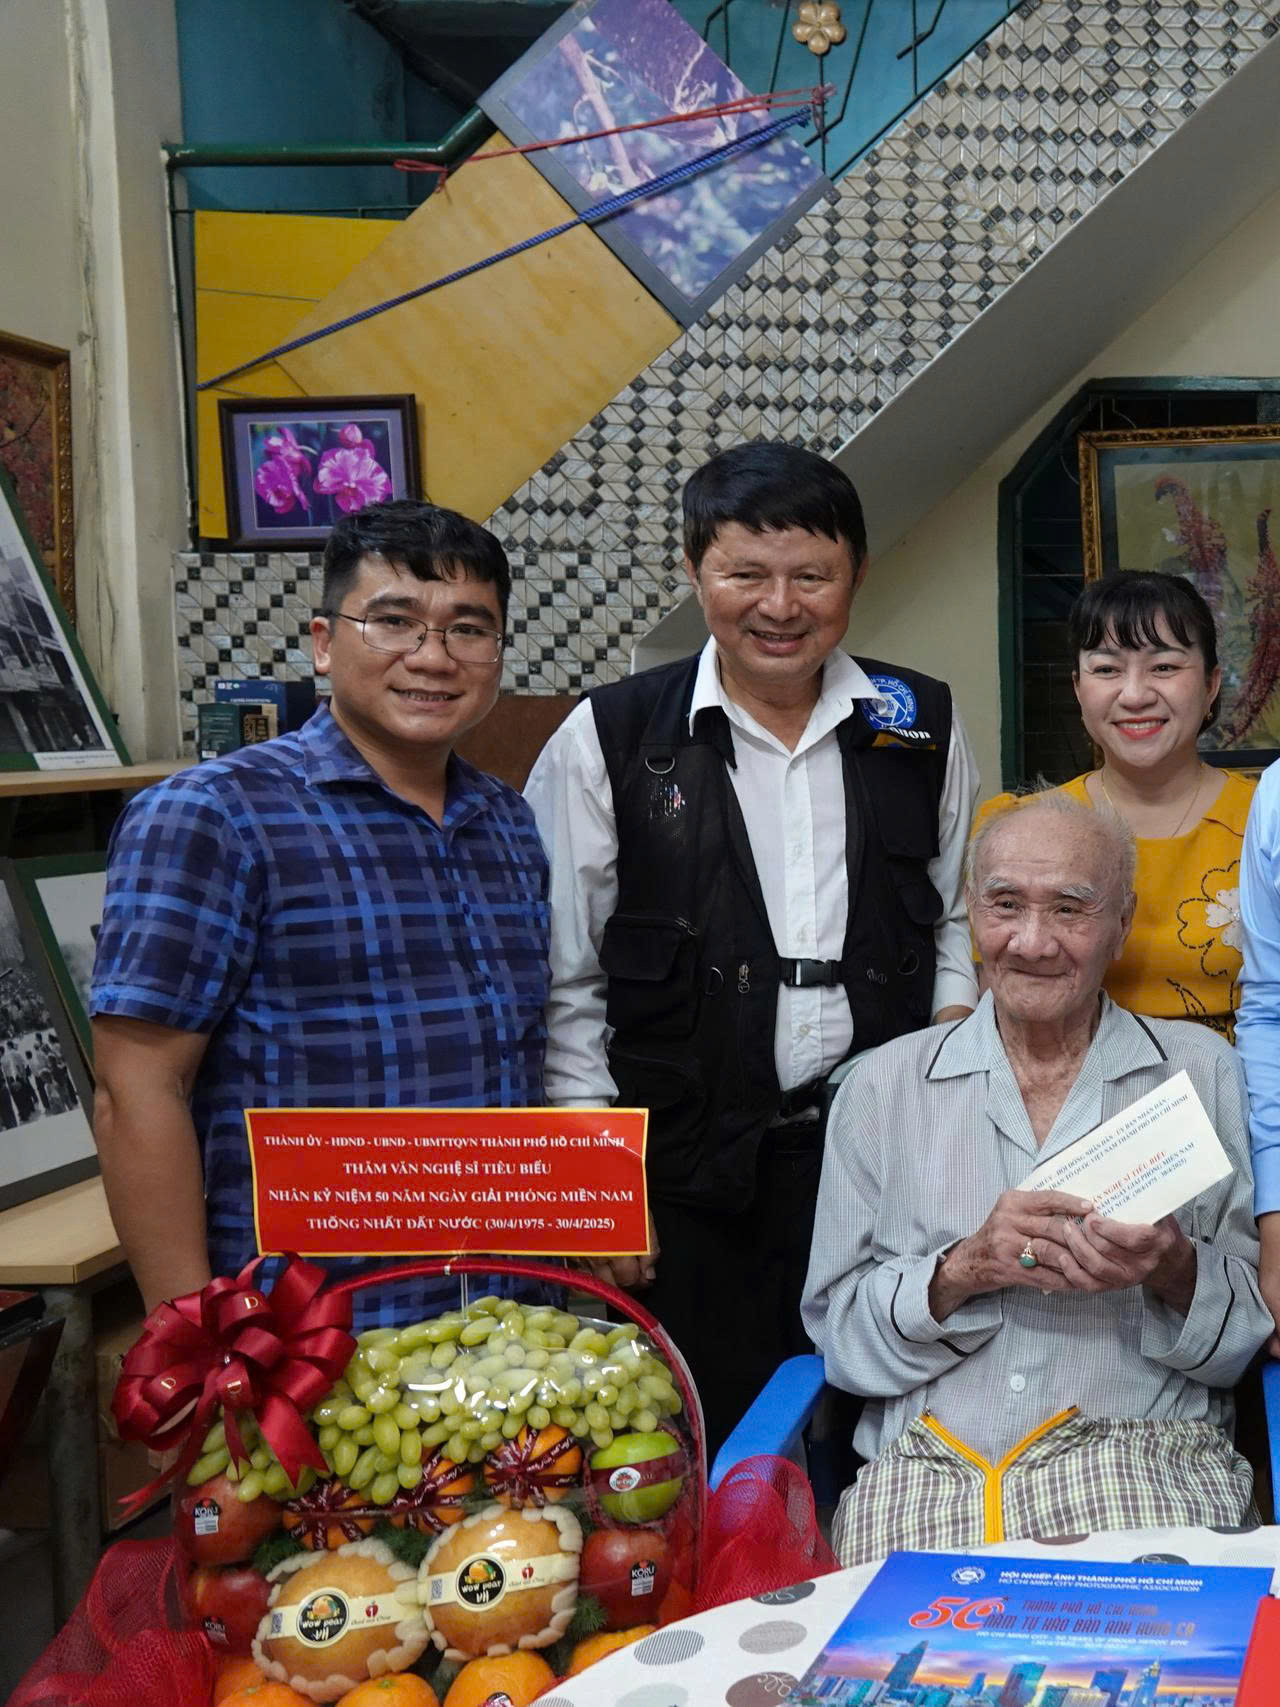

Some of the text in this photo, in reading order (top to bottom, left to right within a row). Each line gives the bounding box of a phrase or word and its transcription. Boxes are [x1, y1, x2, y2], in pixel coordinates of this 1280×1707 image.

[264, 1134, 304, 1146] THÀNH
[306, 1133, 322, 1147] ỦY
[373, 1137, 406, 1147] UBND
[414, 1137, 478, 1148] UBMTTQVN
[480, 1135, 520, 1147] THÀNH
[523, 1135, 547, 1147] PHỐ
[550, 1135, 567, 1147] HỒ
[570, 1136, 590, 1147] CHÍ
[593, 1137, 625, 1147] MINH
[343, 1159, 551, 1176] THĂM VĂN NGHỆ SĨ TIÊU BIỂU
[268, 1188, 633, 1204] NHÂN KỶ NIỆM 50 NĂM NGÀY GIẢI PHÓNG MIỀN NAM
[307, 1215, 359, 1229] THỐNG
[363, 1215, 403, 1229] NHẤT
[406, 1215, 435, 1229] ĐẤT
[439, 1215, 482, 1229] NƯỚC
[485, 1218, 545, 1230] (30/4/1975
[555, 1218, 615, 1230] 30/4/2025)
[195, 1506, 218, 1519] KORU
[632, 1565, 654, 1578] KORU
[1000, 1571, 1019, 1580] HỘI
[1174, 1579, 1203, 1587] MINH
[1074, 1582, 1141, 1591] PHOTOGRAPHIC
[1143, 1584, 1201, 1592] ASSOCIATION
[1104, 1620, 1133, 1635] ANH
